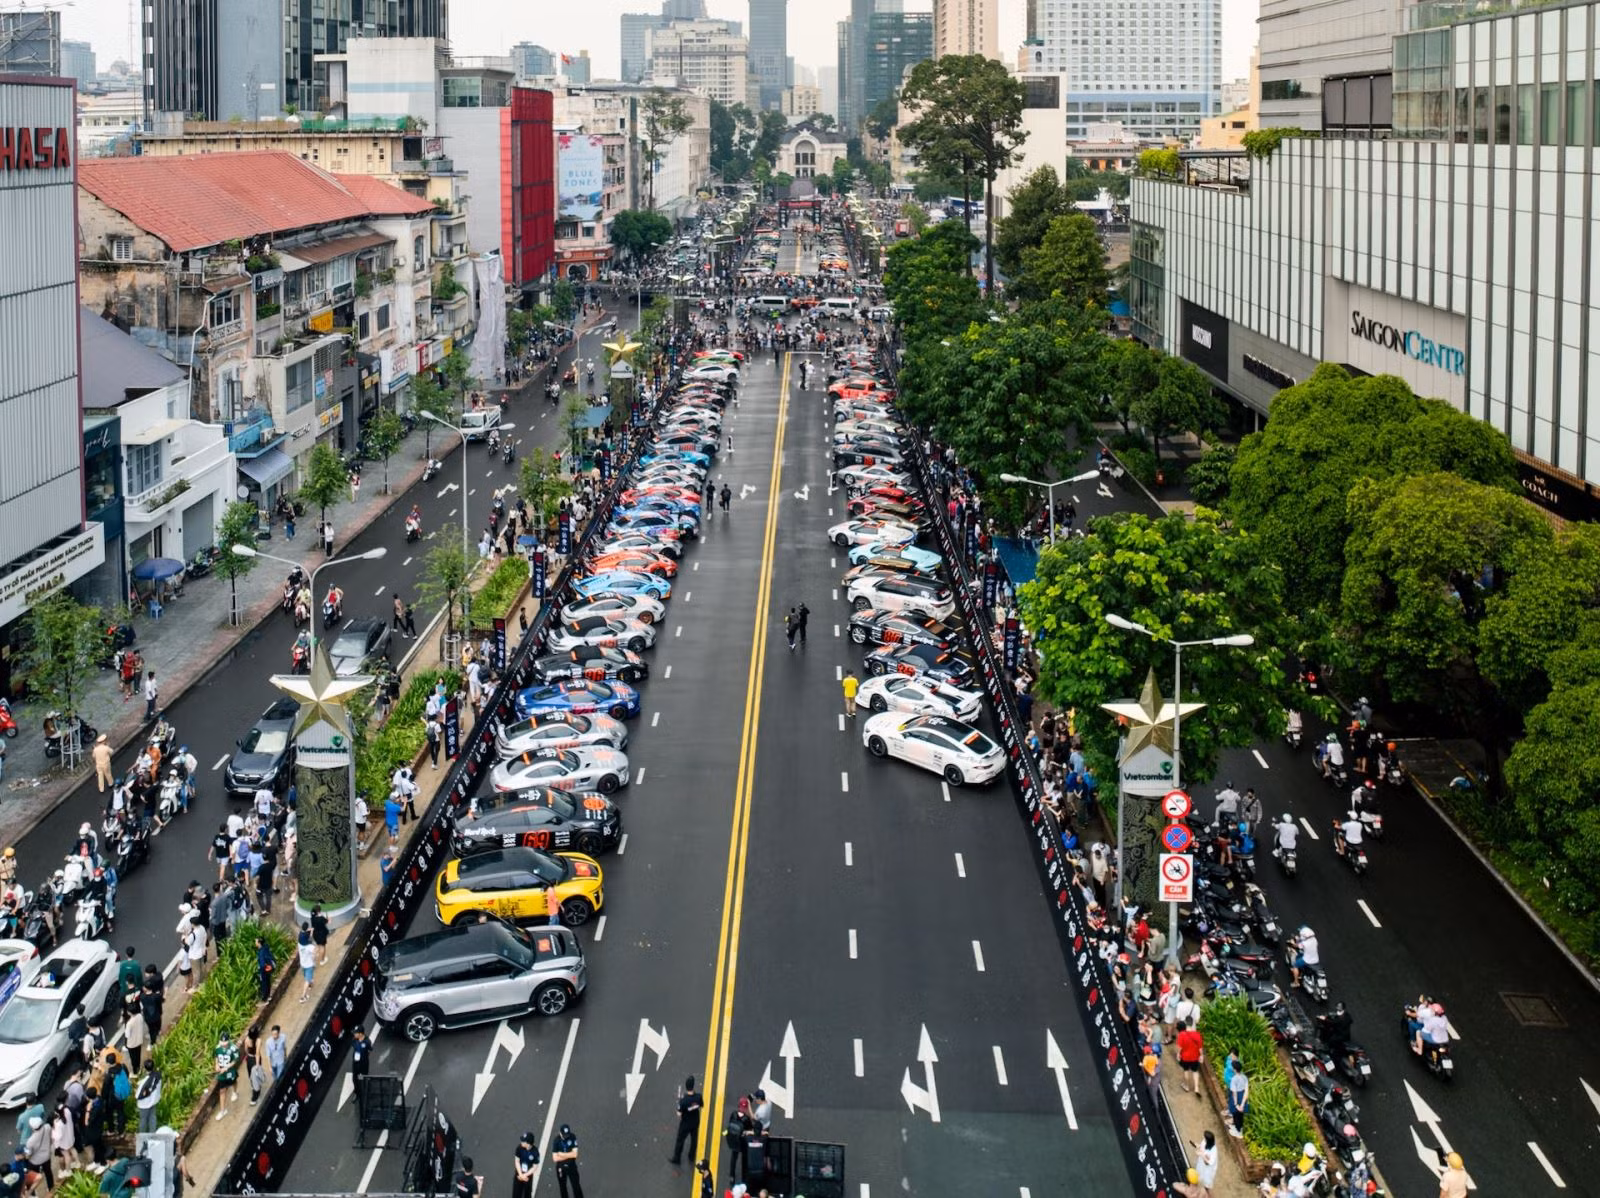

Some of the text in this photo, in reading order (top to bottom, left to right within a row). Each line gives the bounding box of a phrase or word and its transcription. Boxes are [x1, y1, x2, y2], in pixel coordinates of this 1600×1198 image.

[0, 127, 70, 169] HASA
[564, 179, 598, 187] ZONES
[298, 746, 349, 754] Vietcombank
[1123, 772, 1174, 781] Vietcomban
